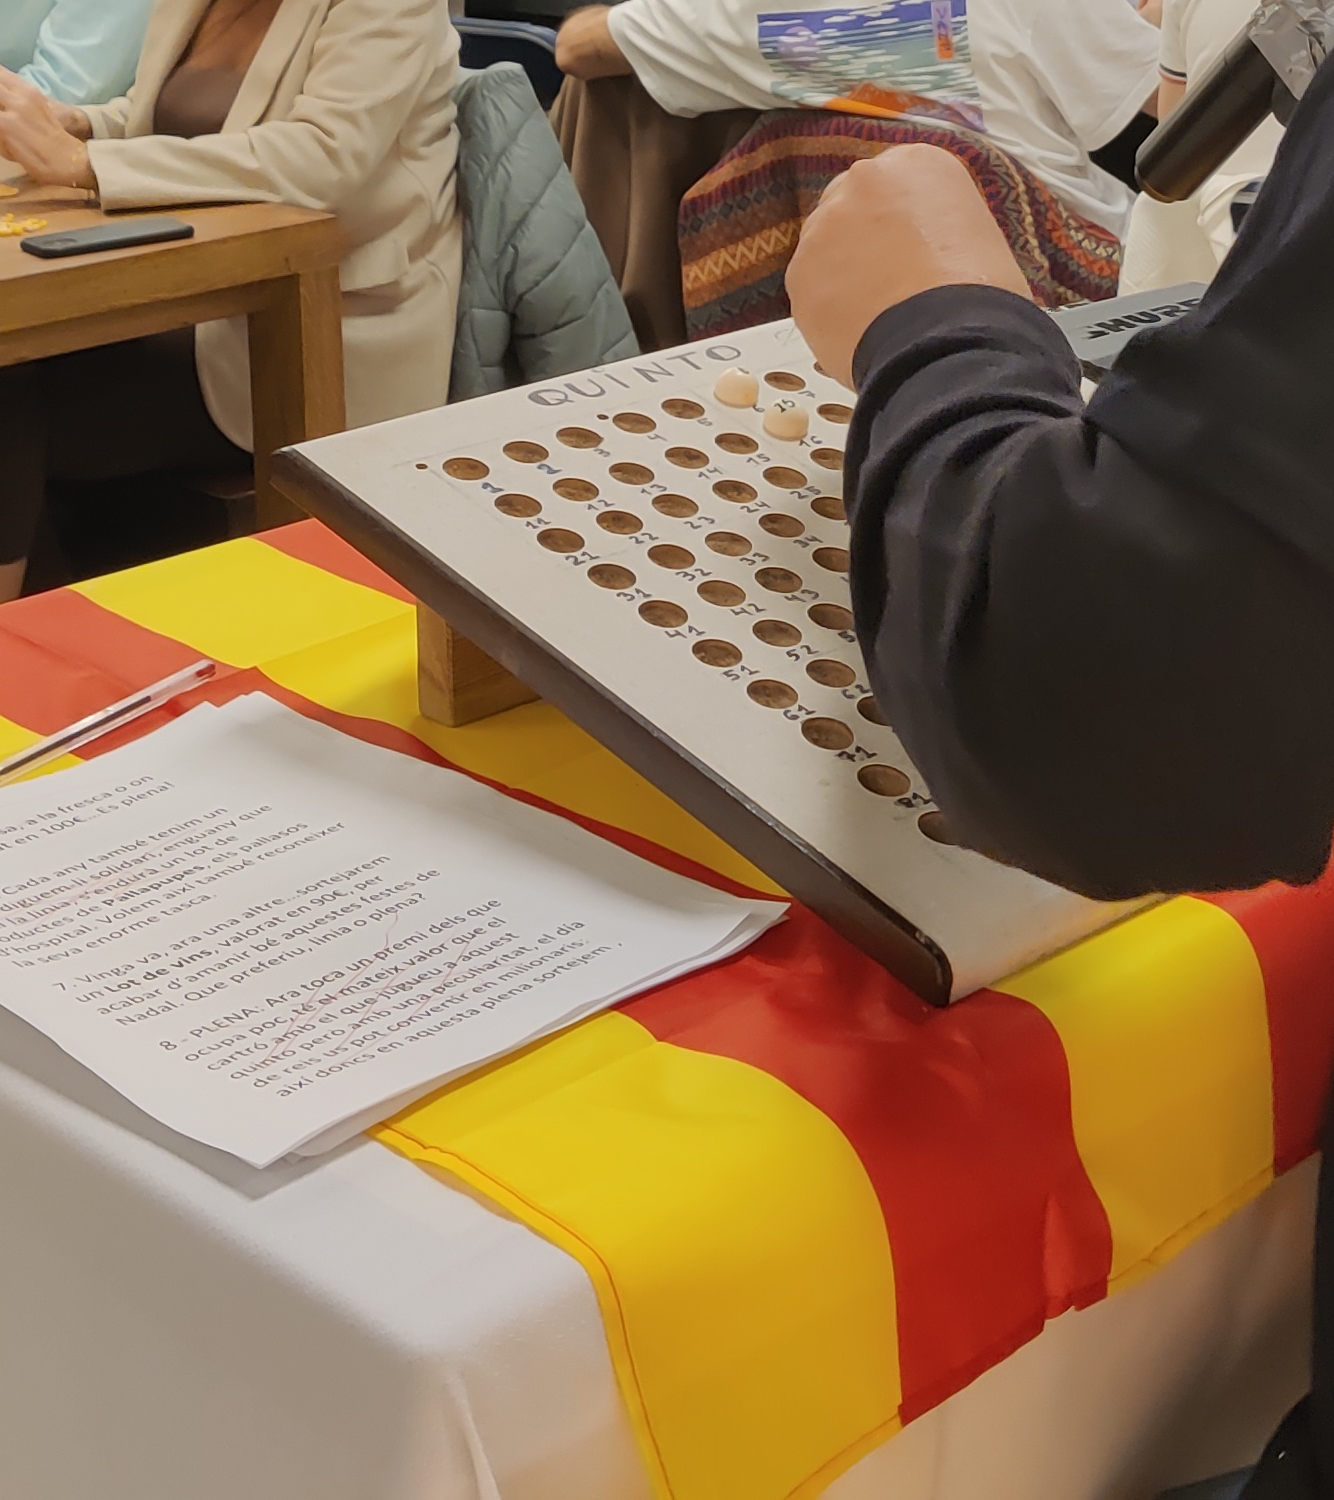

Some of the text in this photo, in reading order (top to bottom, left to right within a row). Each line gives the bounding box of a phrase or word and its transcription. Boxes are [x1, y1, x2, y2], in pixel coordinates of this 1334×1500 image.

[527, 344, 742, 407] QUINTO
[564, 485, 823, 566] 21 22 23 24 25
[587, 499, 616, 511] 12
[640, 483, 668, 496] 13
[697, 466, 723, 480] 14
[746, 453, 771, 466] 15
[616, 534, 824, 602] 31 32 33 34
[664, 588, 820, 639] 41 42 43
[722, 644, 820, 682] 51 52
[782, 703, 817, 721] 61
[13, 833, 40, 845] en
[25, 818, 39, 826] a
[35, 812, 58, 821] la
[56, 792, 114, 815] fresca
[114, 785, 128, 793] o
[129, 775, 155, 788] on
[88, 851, 164, 881] solidari,
[162, 819, 238, 852] enguany
[237, 805, 273, 822] que
[1, 876, 52, 896] Cada
[52, 861, 88, 878] any
[87, 838, 149, 864] també
[147, 818, 204, 842] tenim
[202, 807, 229, 820] un
[4, 916, 30, 926] la
[159, 856, 187, 870] un
[183, 845, 215, 858] lot
[214, 835, 239, 847] de
[75, 905, 103, 918] de
[210, 851, 239, 864] els
[238, 822, 309, 853] pallasos
[94, 898, 162, 925] Volem
[161, 882, 197, 900] així
[194, 858, 256, 886] també
[255, 821, 346, 861] reconeixer
[10, 960, 36, 969] la
[36, 947, 84, 964] seva
[85, 915, 161, 949] enorme
[74, 875, 384, 1004] un Lot de vins, valorat en 90€, per
[74, 963, 136, 984] Vinga
[135, 951, 170, 965] va,
[168, 935, 203, 951] ara
[202, 918, 242, 936] una
[96, 987, 163, 1015] acabar
[249, 936, 281, 953] bé
[280, 902, 363, 941] aquestes
[358, 880, 417, 905] festes
[415, 869, 441, 882] de
[114, 999, 185, 1027] Nadal.
[183, 981, 229, 1002] Que
[228, 946, 314, 985] preferiu,
[352, 918, 368, 928] o
[367, 892, 427, 922] plena?
[158, 1040, 178, 1052] 8
[264, 989, 302, 1008] Ara
[299, 970, 347, 992] toca
[344, 957, 375, 972] un
[372, 930, 429, 962] premi
[428, 915, 467, 935] dels
[466, 900, 502, 918] que
[184, 1033, 249, 1062] ocupa
[247, 1016, 296, 1037] poc,
[317, 992, 339, 1006] el
[337, 964, 407, 997] mateix
[401, 942, 450, 967] valor
[450, 927, 488, 946] que
[486, 916, 507, 929] el
[229, 1049, 297, 1080] quinto
[346, 1009, 392, 1031] amb
[391, 993, 433, 1011] una
[536, 932, 557, 945] el
[270, 1022, 317, 1046] amb
[317, 1012, 340, 1024] el
[339, 997, 379, 1016] que
[442, 961, 459, 970] a
[456, 932, 521, 963] aquest
[275, 945, 612, 1098] així doncs en aquesta plena sortejem
[252, 1073, 282, 1089] de
[281, 1057, 323, 1075] reis
[322, 1043, 350, 1058] us
[349, 1030, 388, 1048] pot
[386, 992, 470, 1033] convertir
[471, 981, 499, 994] en
